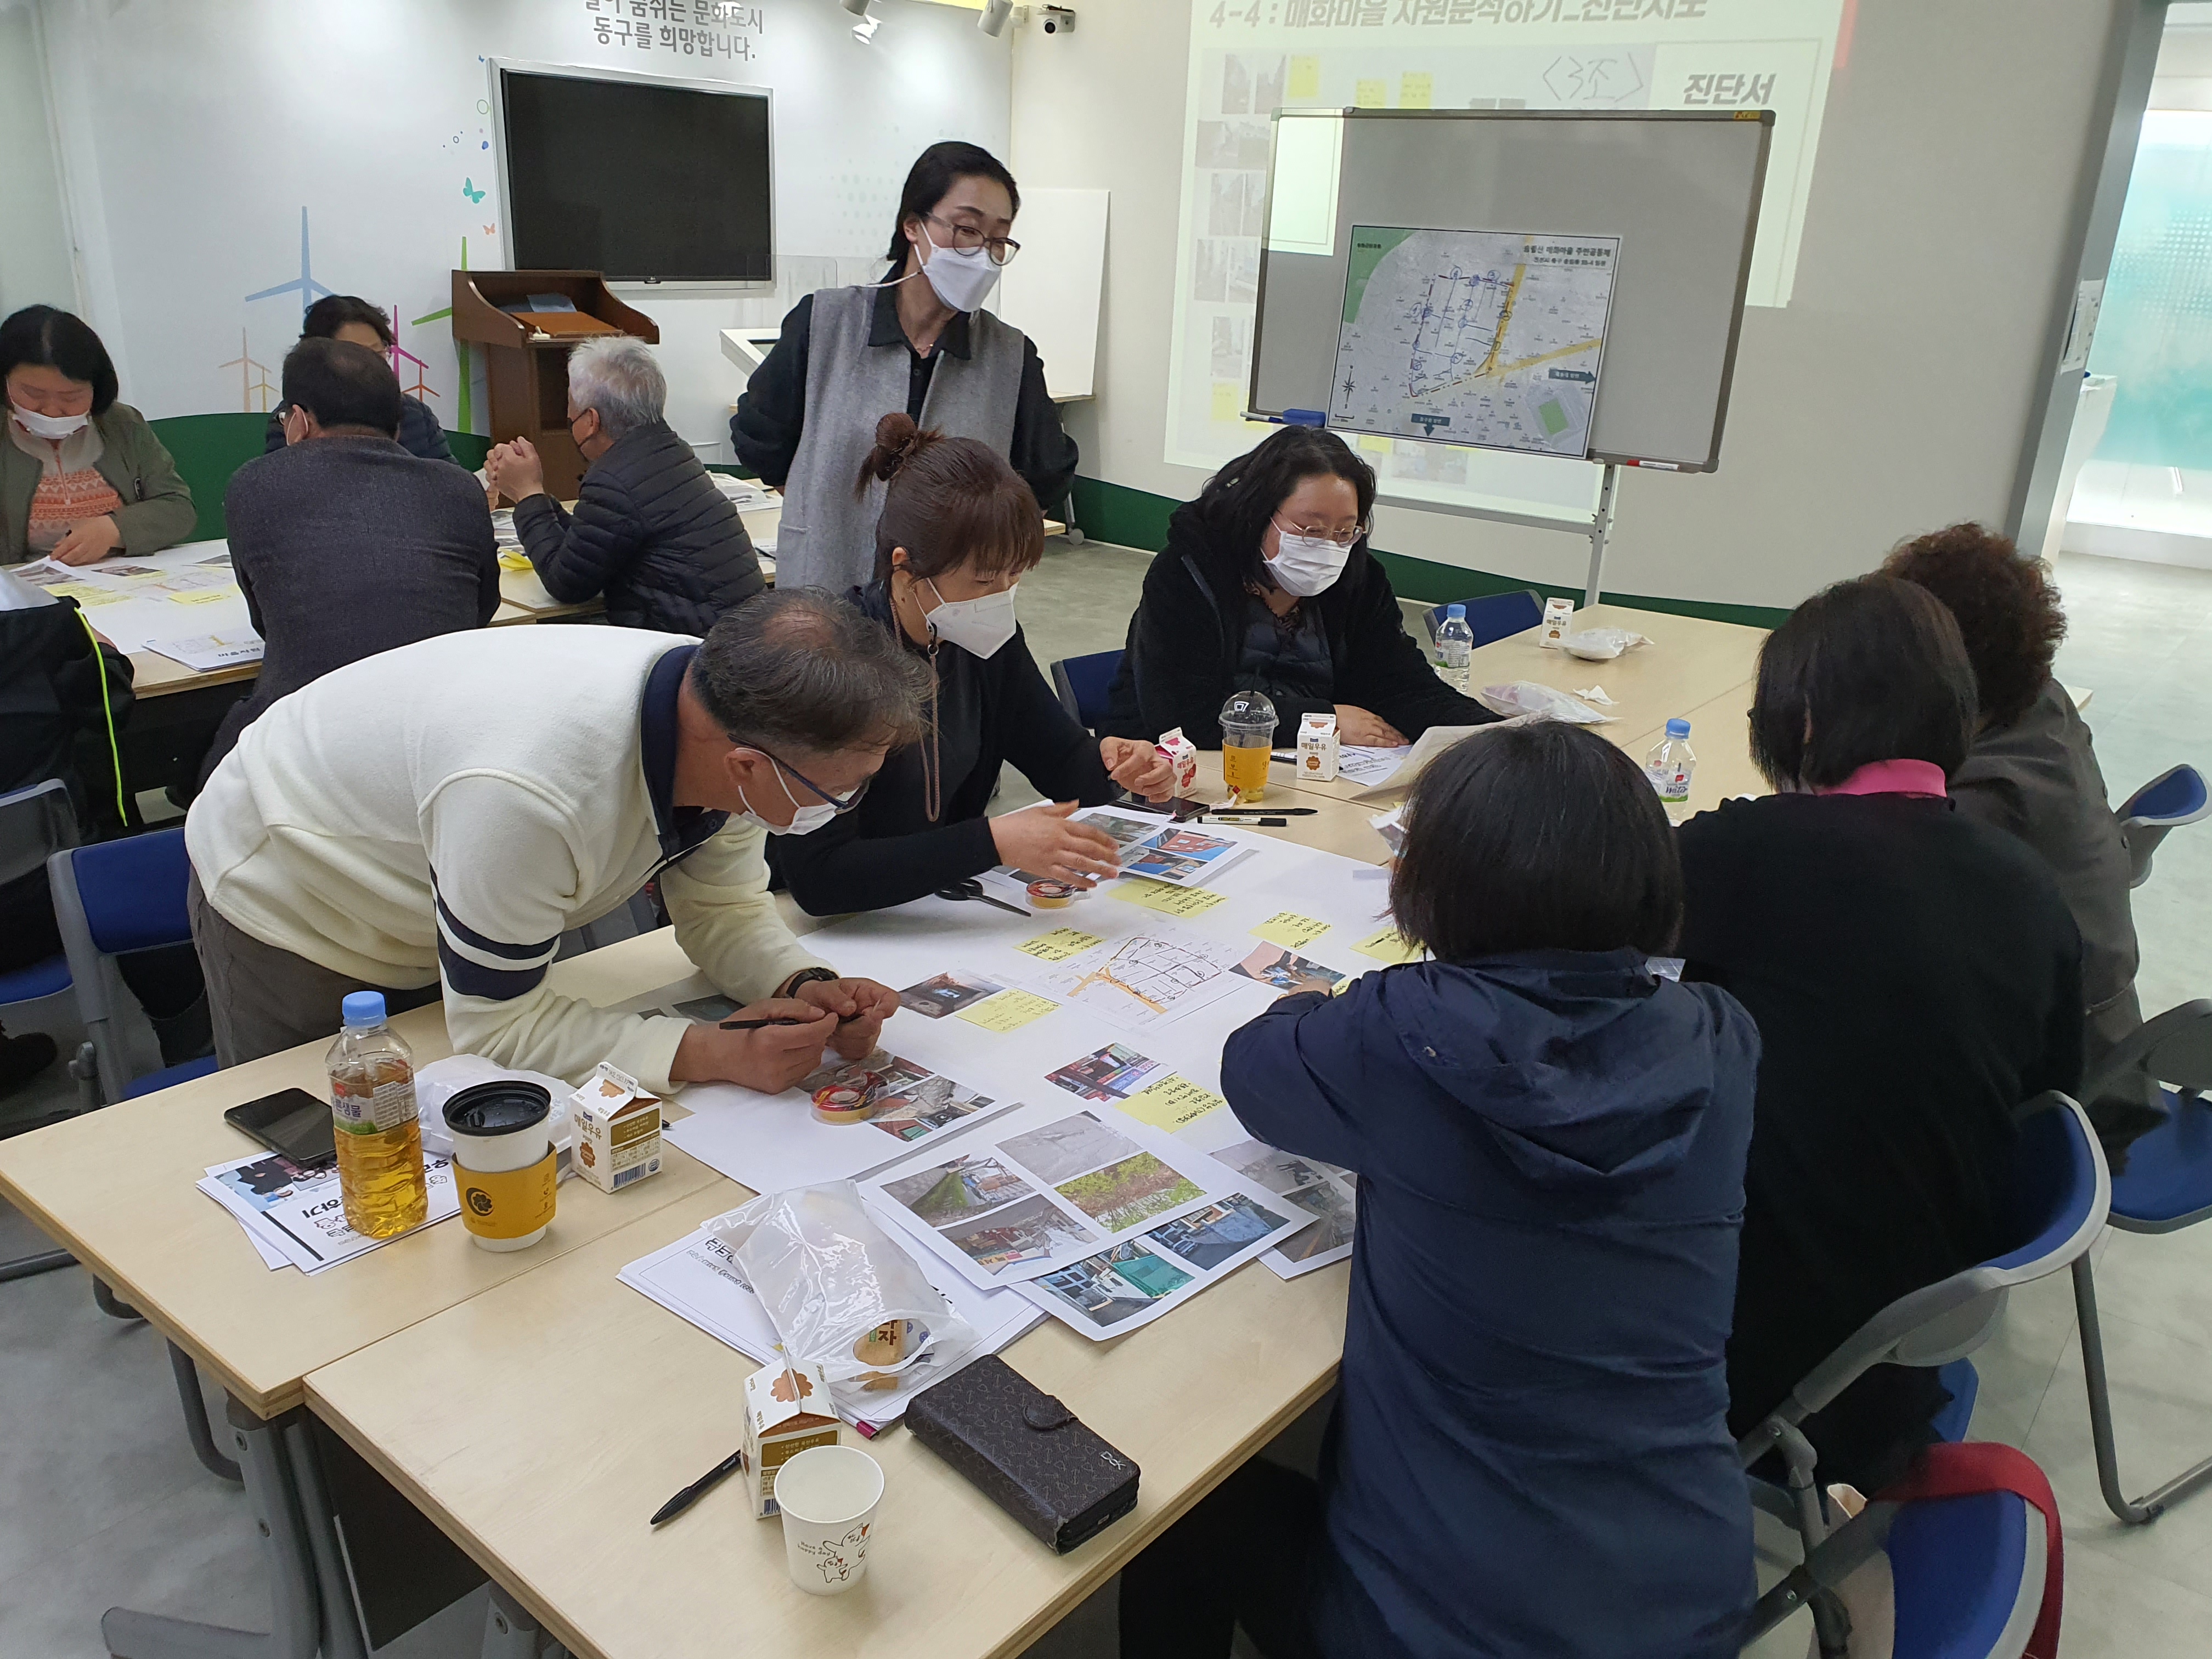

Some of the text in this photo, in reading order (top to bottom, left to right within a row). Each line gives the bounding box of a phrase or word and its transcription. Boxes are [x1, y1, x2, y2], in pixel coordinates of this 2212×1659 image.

[693, 0, 763, 34] 문화도시
[1209, 1, 1261, 28] 4-4
[1284, 0, 1387, 27] 매화마을
[594, 16, 755, 61] 동구를 희망합니다.
[1683, 74, 1778, 105] 진단서
[1301, 742, 1327, 751] 매일우유
[1177, 757, 1194, 769] 매일우유
[1666, 786, 1688, 794] Water
[574, 1113, 602, 1141] 매일우유
[797, 1543, 816, 1556] happy
[800, 1541, 816, 1550] Have
